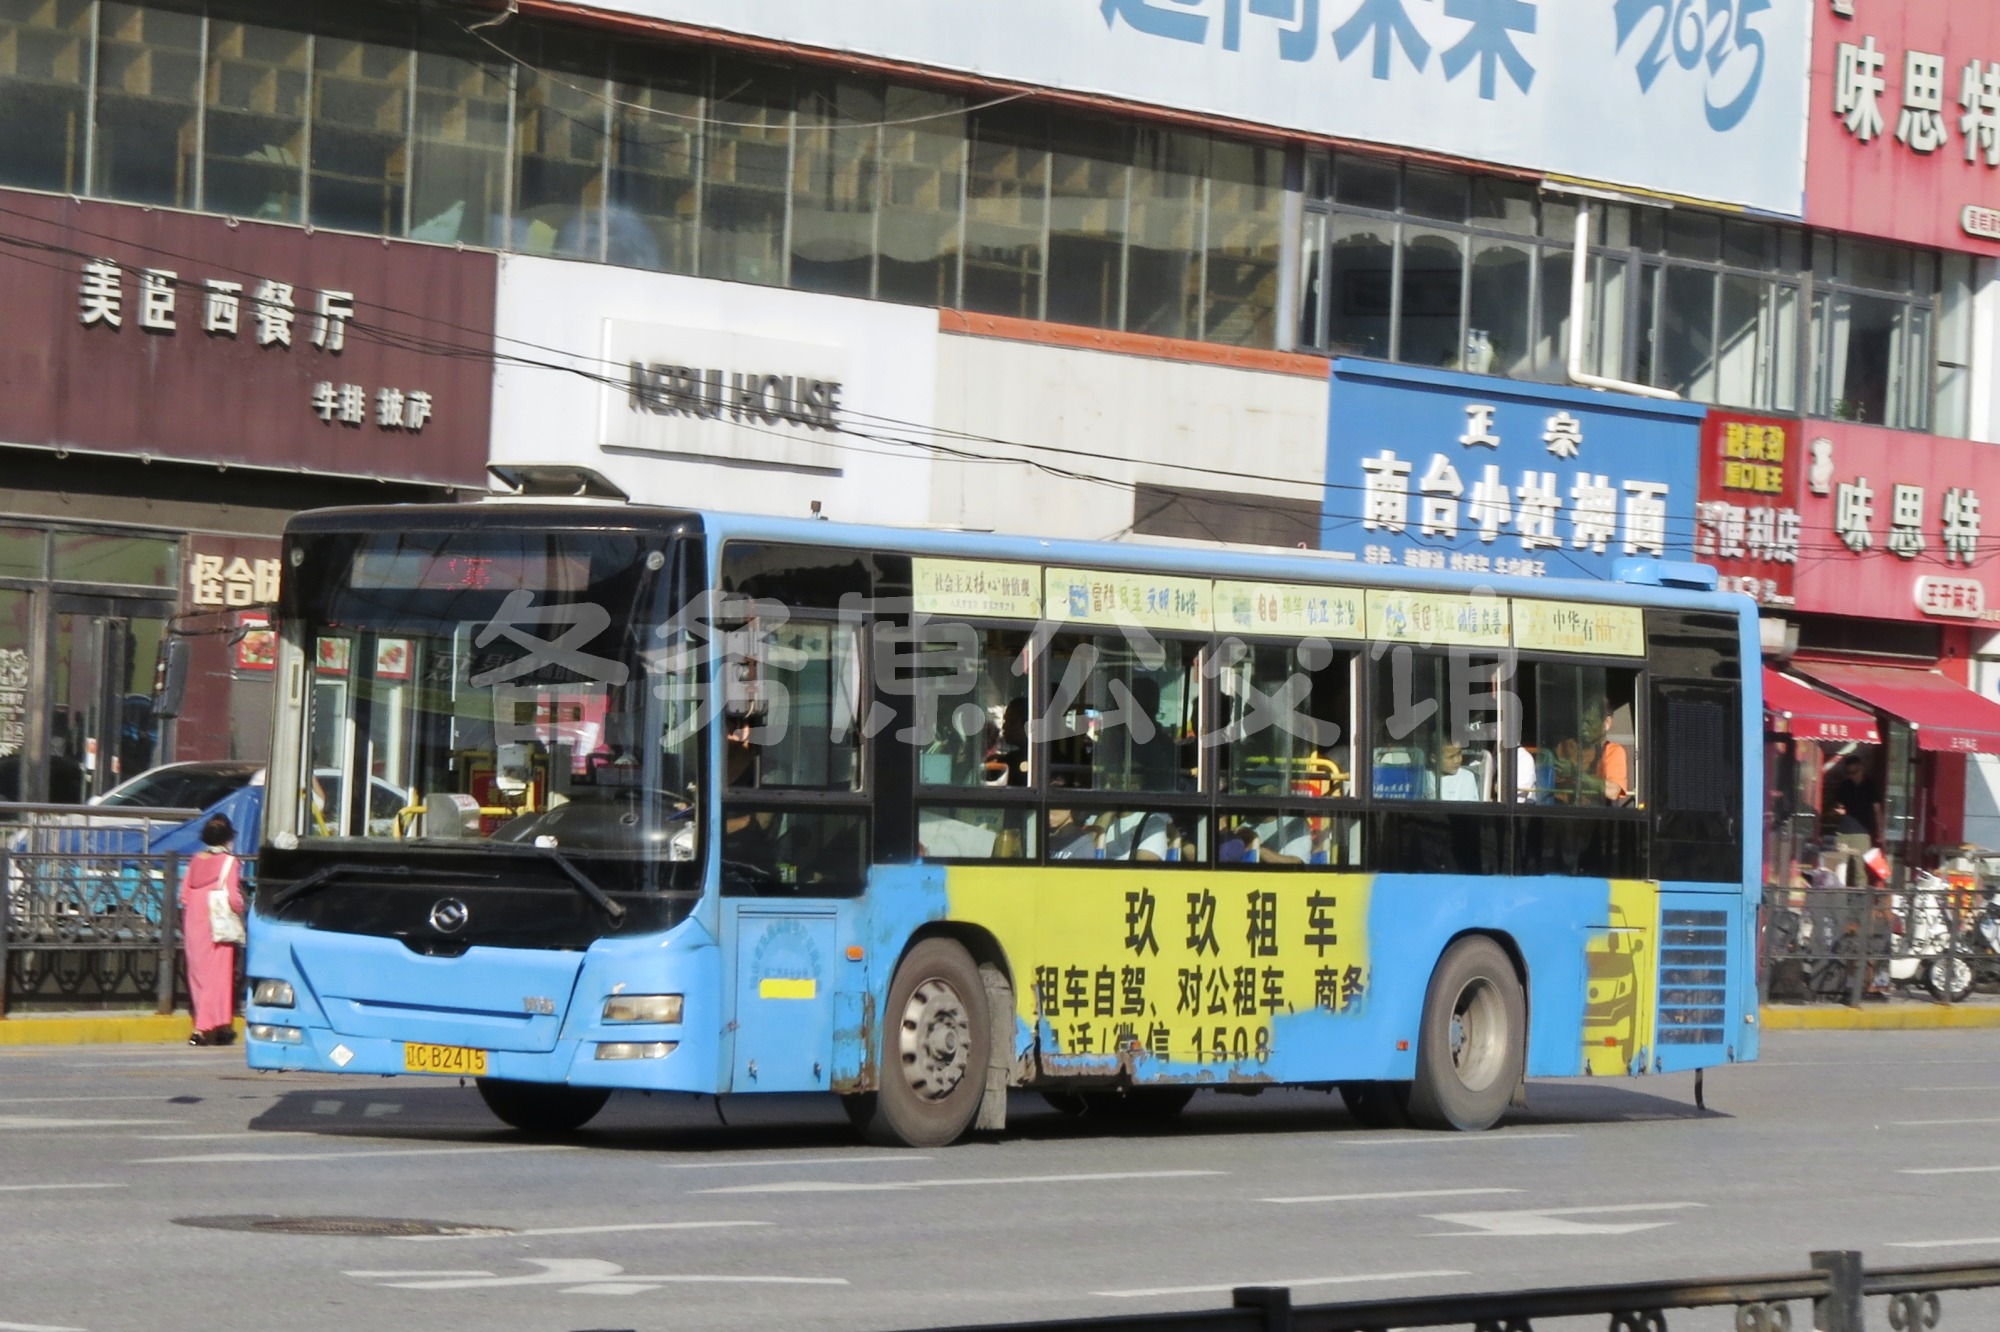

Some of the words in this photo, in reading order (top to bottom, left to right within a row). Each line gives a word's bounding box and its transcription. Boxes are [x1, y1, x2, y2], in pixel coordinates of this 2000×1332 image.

[1834, 35, 2000, 167] 味思特
[80, 257, 354, 352] 美臣西餐厅
[312, 380, 365, 425] 牛排
[376, 387, 432, 431] 披萨
[730, 372, 843, 433] HOUSE
[1458, 404, 1583, 459] 正宗
[1835, 476, 1981, 566] 味思特
[1124, 887, 1338, 958] 玖玖租车
[1035, 965, 1373, 1017] 租车自驾、对公租车、商务
[1191, 1026, 1270, 1066] 1508
